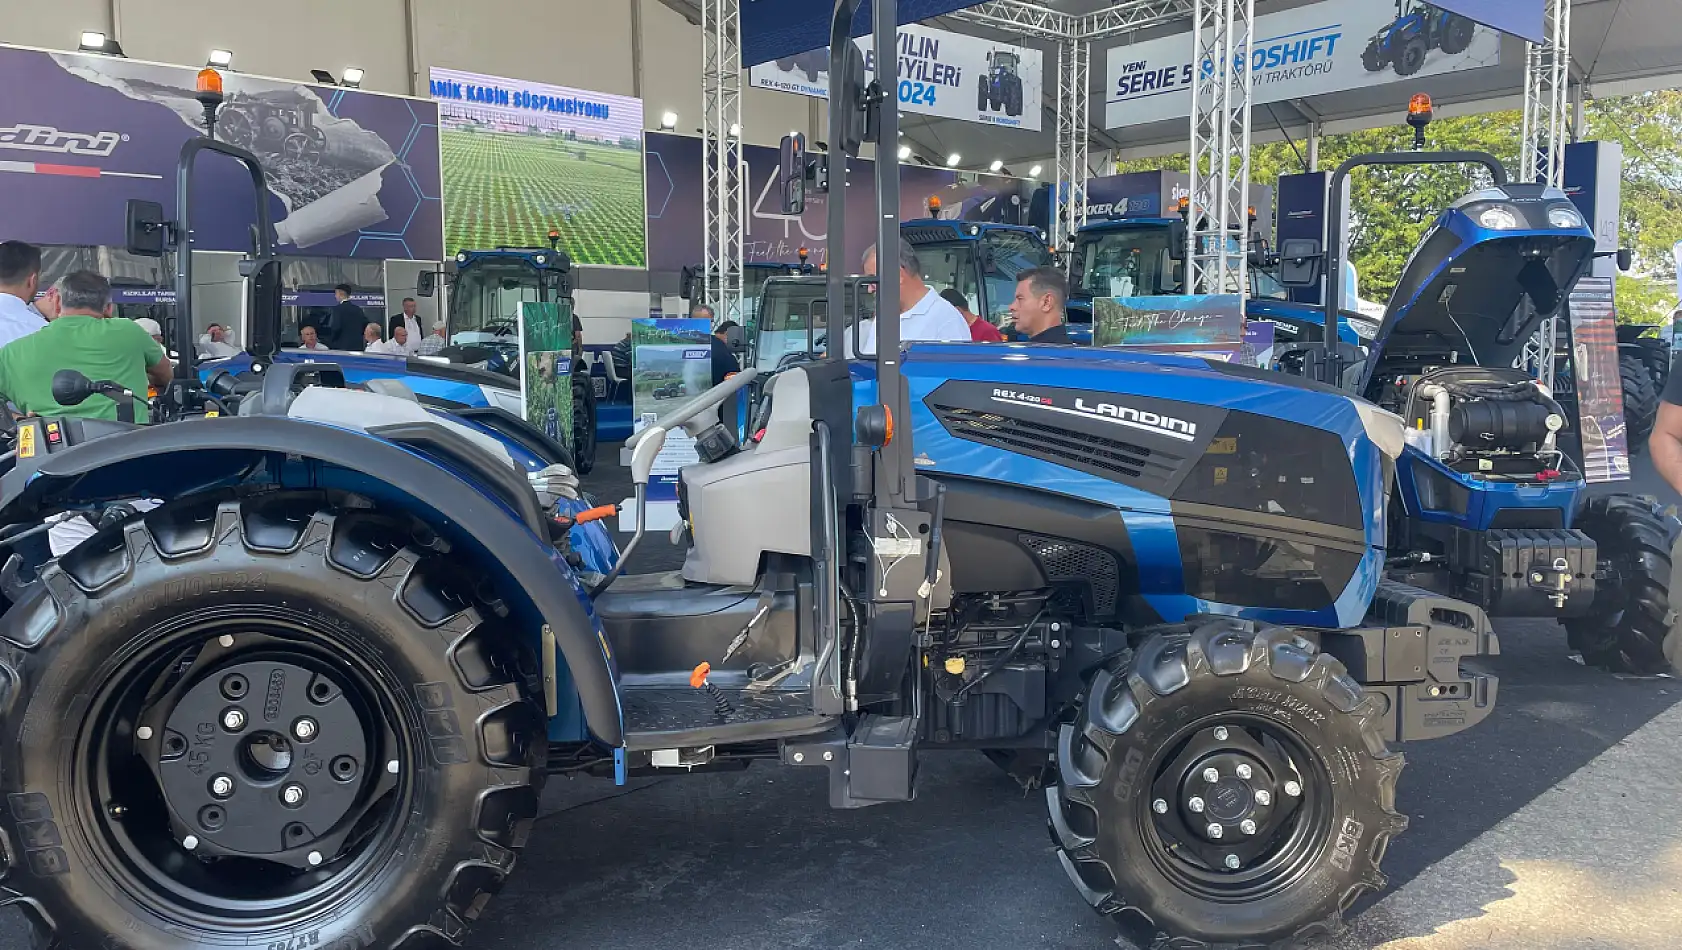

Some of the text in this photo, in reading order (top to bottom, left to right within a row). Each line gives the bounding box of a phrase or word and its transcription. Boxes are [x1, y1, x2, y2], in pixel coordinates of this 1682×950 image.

[1200, 33, 1342, 80] RBOSHIFT
[1116, 66, 1177, 96] SERIE
[1266, 59, 1334, 84] TRAKTÖRÜ
[466, 85, 509, 105] KABİN
[897, 80, 937, 106] 024
[993, 388, 1017, 399] REX
[1074, 397, 1196, 435] LANDINI
[1330, 815, 1364, 872] BKT
